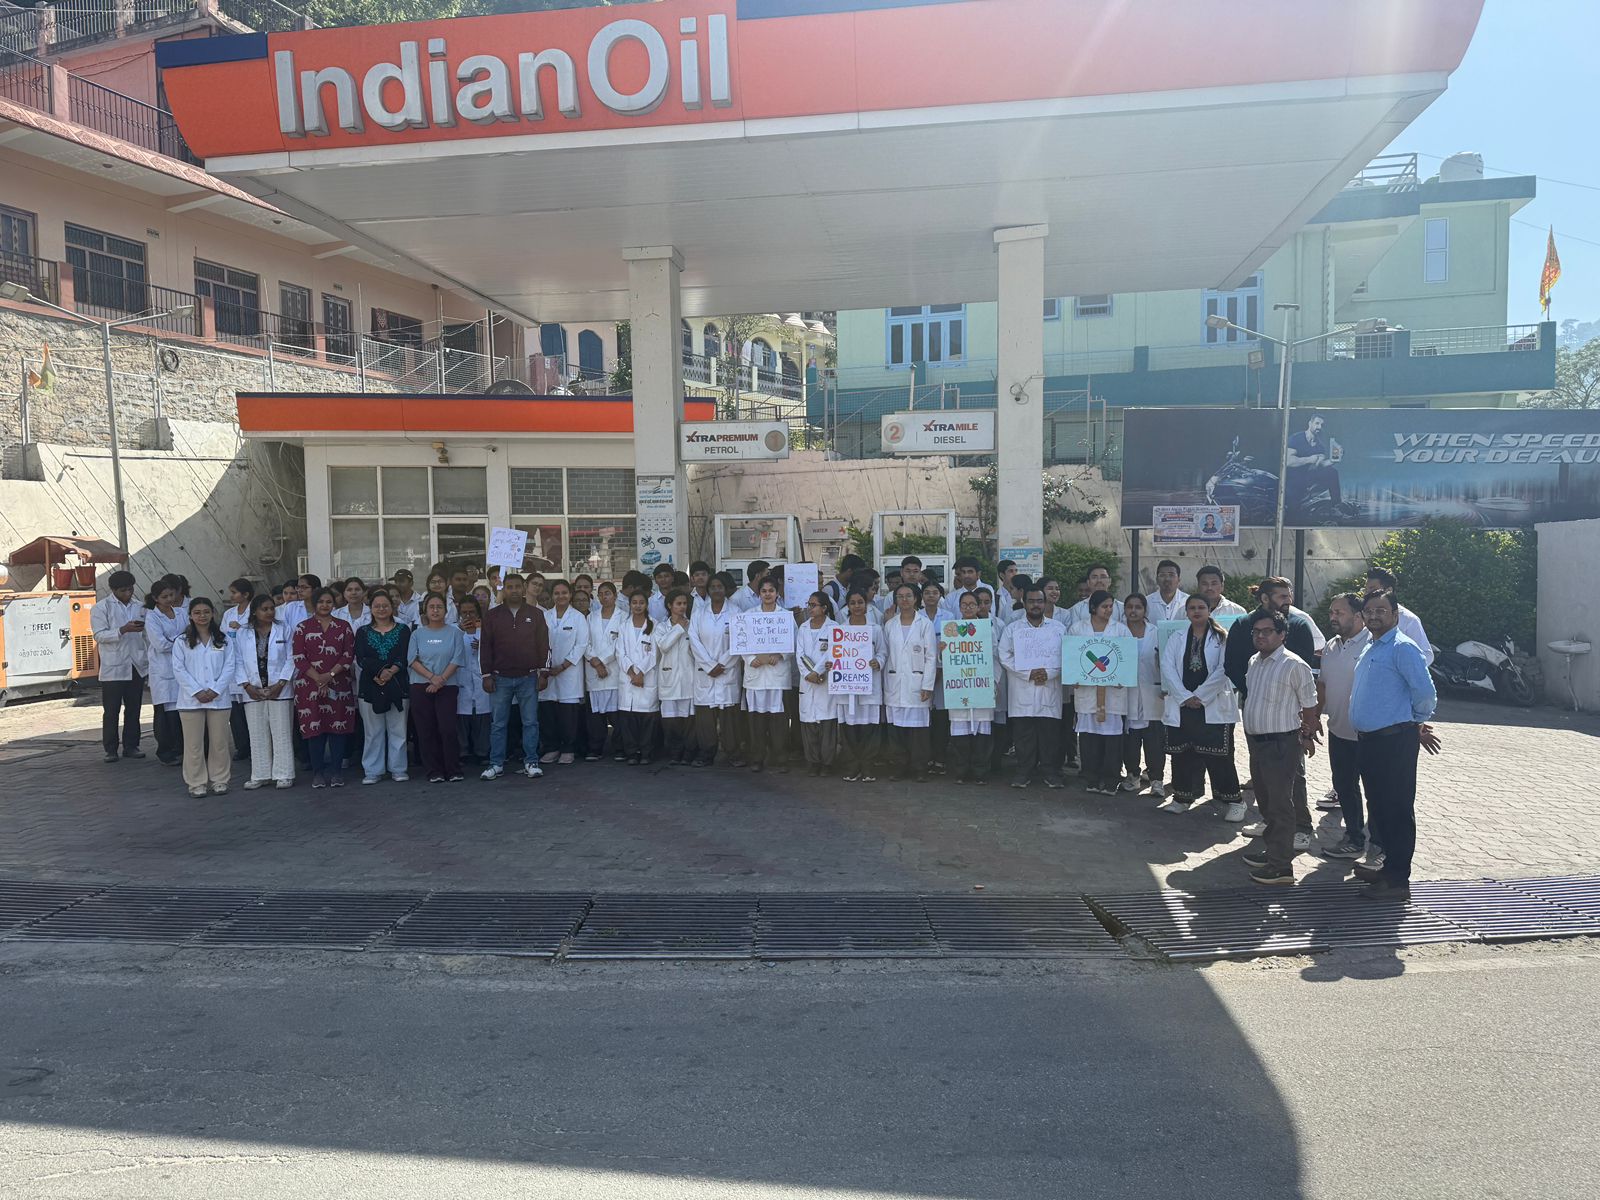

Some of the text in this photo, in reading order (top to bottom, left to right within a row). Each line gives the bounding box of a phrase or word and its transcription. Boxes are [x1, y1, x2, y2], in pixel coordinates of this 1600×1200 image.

[274, 14, 732, 138] IndianOil
[923, 420, 978, 432] XTRAMILE
[686, 431, 759, 443] XTRAPREMIUM
[889, 425, 900, 440] 2
[933, 436, 966, 444] DIESEL
[1393, 432, 1495, 447] WHEN
[704, 446, 739, 454] PETROL
[1393, 449, 1600, 464] YOUR DEFAU
[833, 628, 869, 642] DRUGS
[832, 644, 859, 659] END
[949, 640, 984, 653] CHOOSE
[832, 659, 851, 670] ALL
[949, 653, 988, 666] HEALTH,
[833, 671, 870, 683] DREAMS
[960, 667, 977, 678] NOT
[945, 677, 990, 689] ADDICTION!
